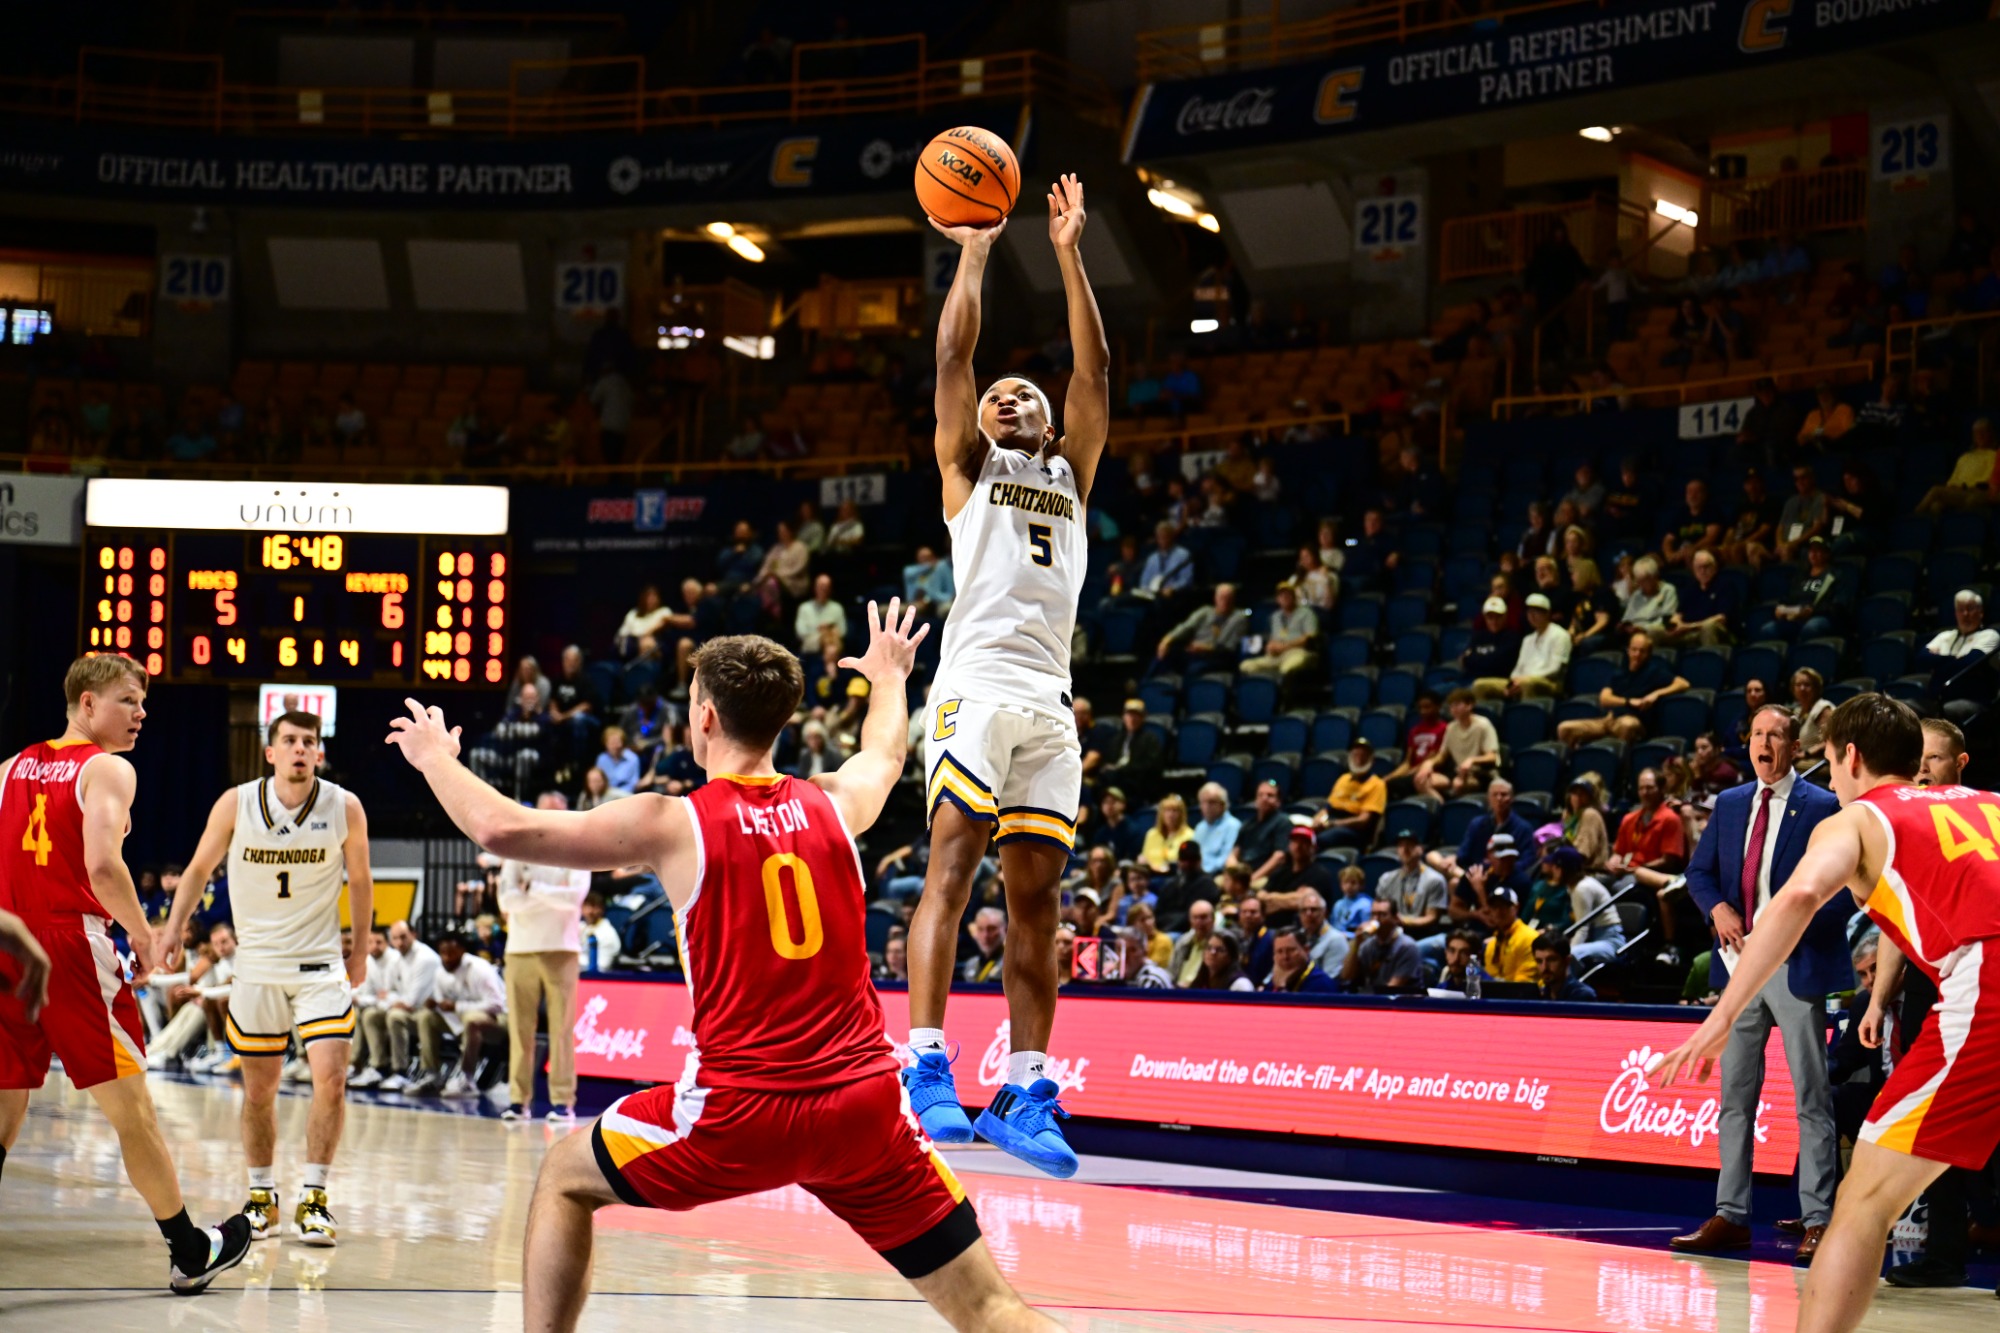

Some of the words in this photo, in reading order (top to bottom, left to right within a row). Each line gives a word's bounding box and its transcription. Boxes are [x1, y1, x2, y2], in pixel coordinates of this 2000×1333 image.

[1388, 40, 1502, 86] OFFICIAL
[1508, 2, 1717, 66] REFRESHMENT
[1478, 54, 1615, 105] PARTNER
[1881, 123, 1938, 173] 213
[97, 152, 226, 189] OFFICIAL
[235, 158, 429, 193] HEALTHCARE
[436, 163, 574, 195] PARTNER
[937, 151, 983, 187] NCAA
[1362, 201, 1417, 244] 212
[167, 260, 223, 297] 210
[564, 267, 618, 304] 210
[1693, 402, 1739, 434] 114
[240, 499, 352, 524] unum
[990, 481, 1075, 524] CHATTANOOG
[262, 534, 343, 571] 16:48
[1028, 522, 1053, 567] 5
[105, 574, 115, 595] 1
[215, 590, 237, 626] 5
[294, 596, 304, 622] 1
[381, 592, 404, 629] 6
[461, 606, 473, 628] 1
[90, 627, 113, 647] 11
[192, 635, 211, 665] 0
[227, 637, 246, 664] 4
[278, 636, 298, 667] 6
[313, 639, 323, 665] 1
[339, 639, 359, 666] 4
[392, 640, 403, 667] 1
[266, 692, 328, 725] EIT
[22, 792, 52, 867] 4
[735, 798, 810, 838] LISTON
[242, 847, 326, 865] CHATTANOOGA
[276, 871, 291, 899] 1
[761, 851, 824, 960] 0
[1130, 1053, 1218, 1083] Download
[1217, 1059, 1249, 1085] the
[1362, 1067, 1405, 1100] App
[1406, 1072, 1450, 1098] and
[1450, 1078, 1511, 1102] score
[1513, 1076, 1550, 1111] big
